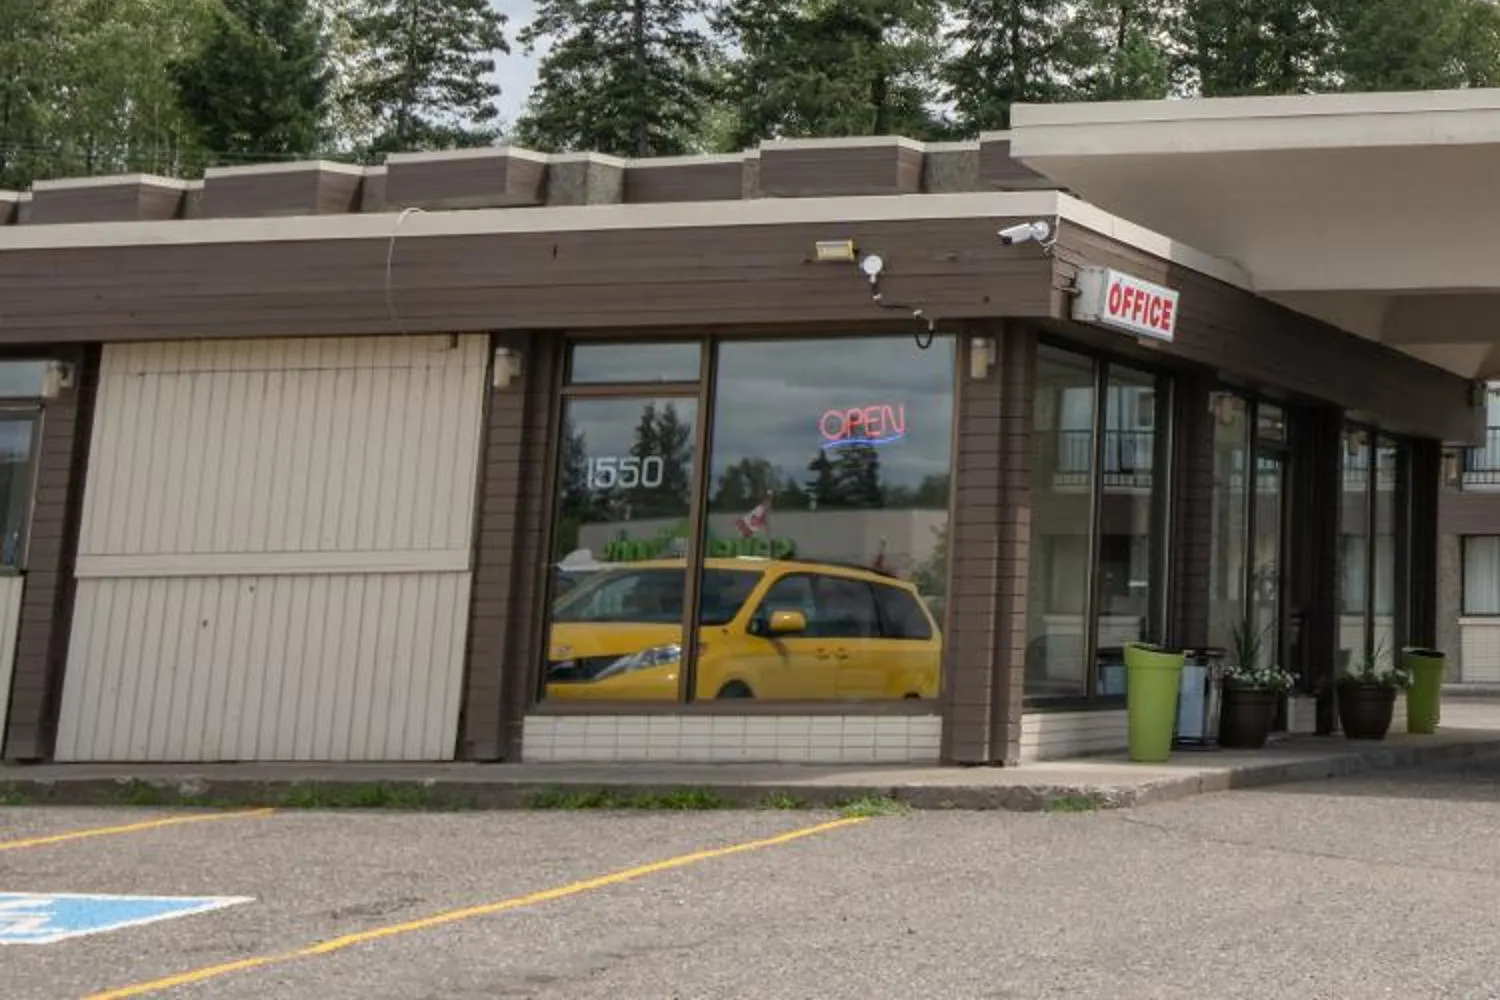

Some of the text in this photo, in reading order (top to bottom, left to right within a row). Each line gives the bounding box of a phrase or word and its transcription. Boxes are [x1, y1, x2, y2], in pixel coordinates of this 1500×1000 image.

[1108, 283, 1173, 331] OFFICE
[818, 404, 904, 440] OPEN
[587, 456, 664, 489] 1550
